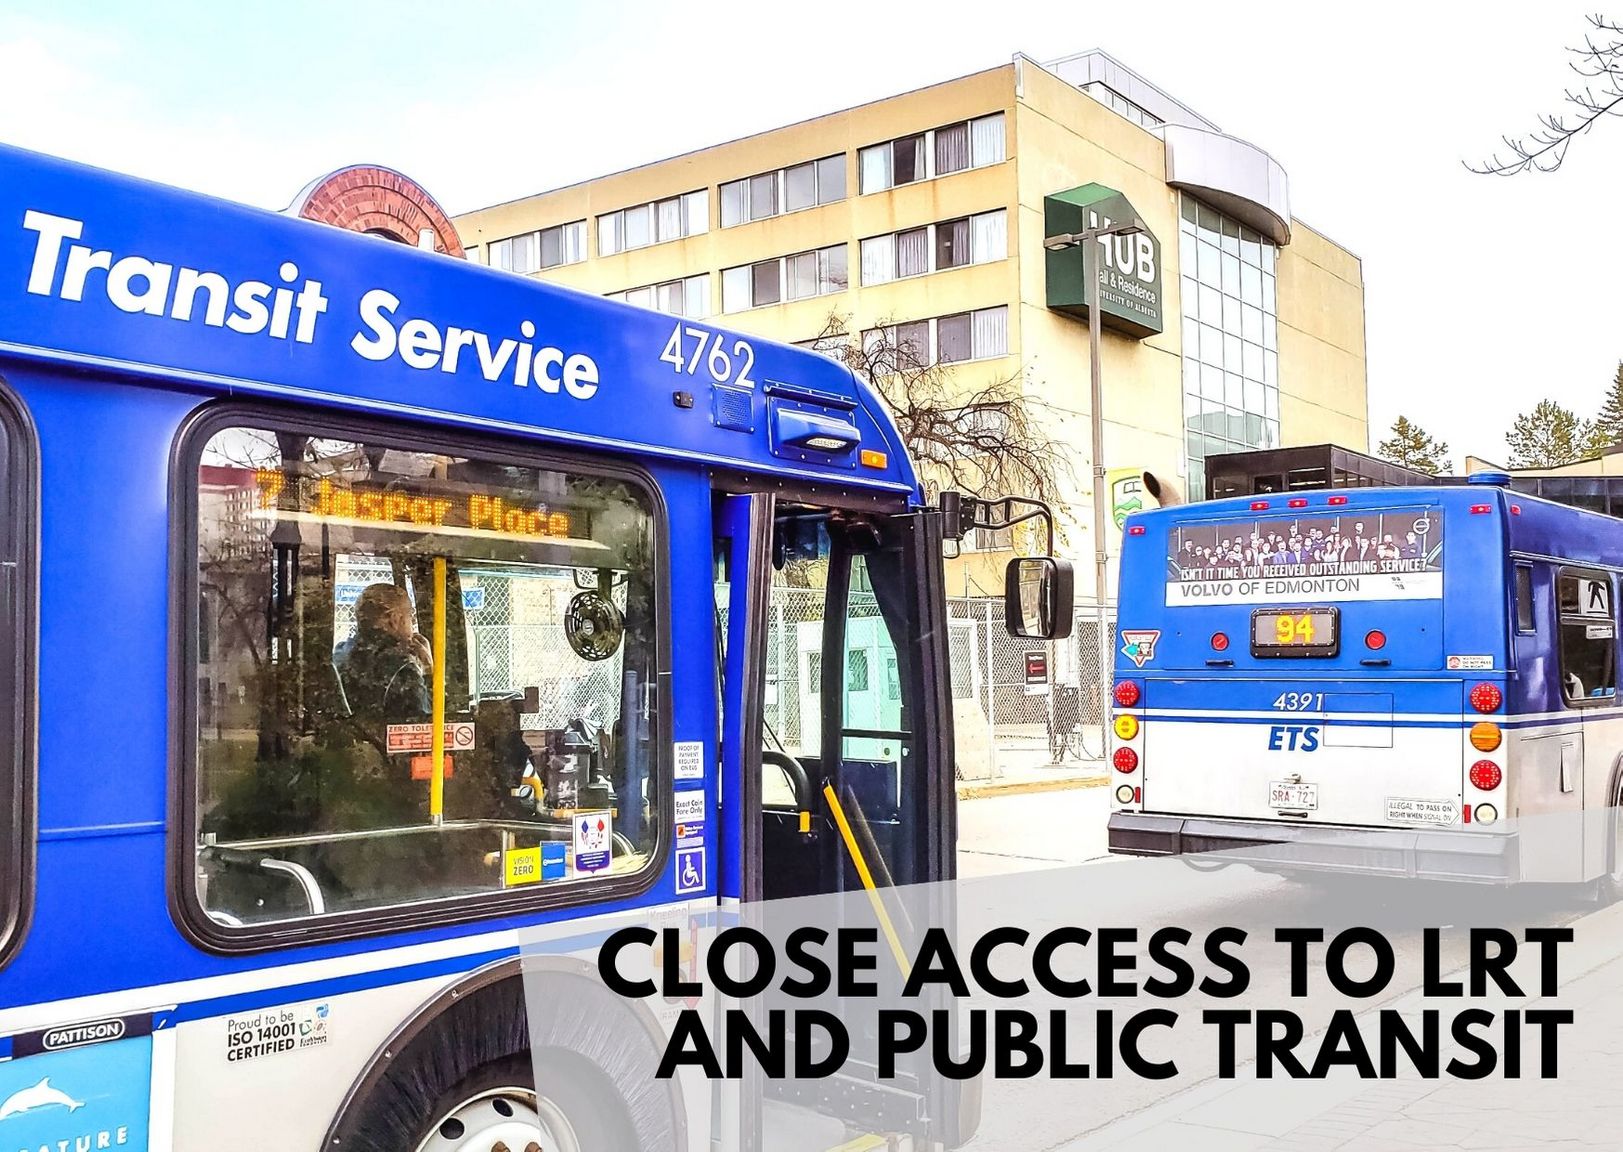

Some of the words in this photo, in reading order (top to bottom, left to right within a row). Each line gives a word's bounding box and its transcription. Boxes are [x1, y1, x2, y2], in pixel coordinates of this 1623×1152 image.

[1109, 272, 1118, 289] &
[1118, 275, 1156, 304] Residence
[22, 209, 329, 344] Transit
[350, 289, 600, 401] Service
[1126, 298, 1134, 310] OF
[1135, 302, 1157, 318] ALBERTA
[659, 321, 756, 388] 4762
[467, 493, 571, 539] Place
[1180, 567, 1204, 581] ISN'T
[1205, 567, 1214, 580] IT
[1217, 566, 1239, 580] TIME
[1241, 565, 1260, 579] YOU
[1263, 563, 1307, 578] RECEIVED
[1309, 560, 1378, 576] OUTSTANDING
[1380, 558, 1427, 573] SERVICE?
[1181, 583, 1233, 597] VOLVO
[1238, 581, 1260, 596] OF
[1265, 577, 1360, 595] EDMONTON
[1276, 613, 1316, 645] 94
[1272, 692, 1323, 711] 4391
[411, 724, 454, 732] TOLECE
[1268, 726, 1320, 752] ETS
[676, 800, 690, 808] Exact
[690, 806, 703, 815] Only
[1389, 801, 1413, 810] ILLEGAL
[1416, 803, 1424, 811] TO
[1442, 804, 1452, 812] ON
[1406, 812, 1423, 820] WHEN
[513, 855, 534, 865] VISION
[513, 865, 534, 876] ZERO
[228, 1014, 261, 1032] Proud
[265, 1015, 276, 1025] to
[280, 1010, 294, 1022] be
[49, 1023, 121, 1045] PATTISON
[228, 1030, 253, 1048] ISO
[257, 1022, 296, 1042] 14001
[227, 1038, 295, 1062] CERTIFIED
[18, 1125, 128, 1152] TURE
